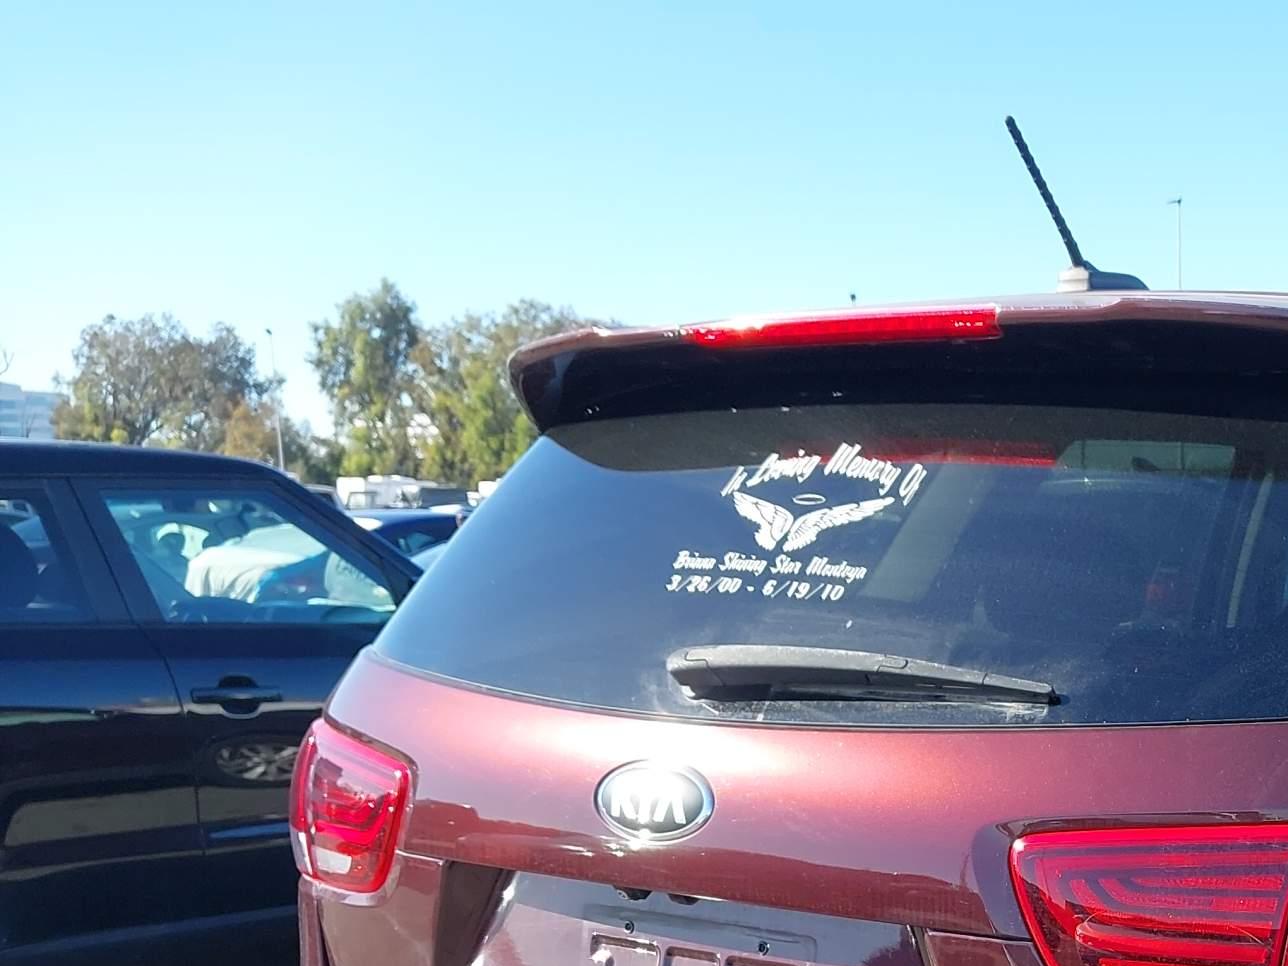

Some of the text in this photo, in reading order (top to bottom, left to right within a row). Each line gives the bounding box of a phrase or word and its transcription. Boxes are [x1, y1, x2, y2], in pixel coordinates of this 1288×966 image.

[746, 448, 821, 488] Loving
[824, 442, 902, 496] Memory
[899, 463, 928, 506] Of
[719, 551, 768, 576] Shining
[770, 553, 802, 575] Star
[666, 574, 743, 594] 3/26/00
[762, 579, 845, 601] 6/19/10
[608, 770, 688, 826] KIA
